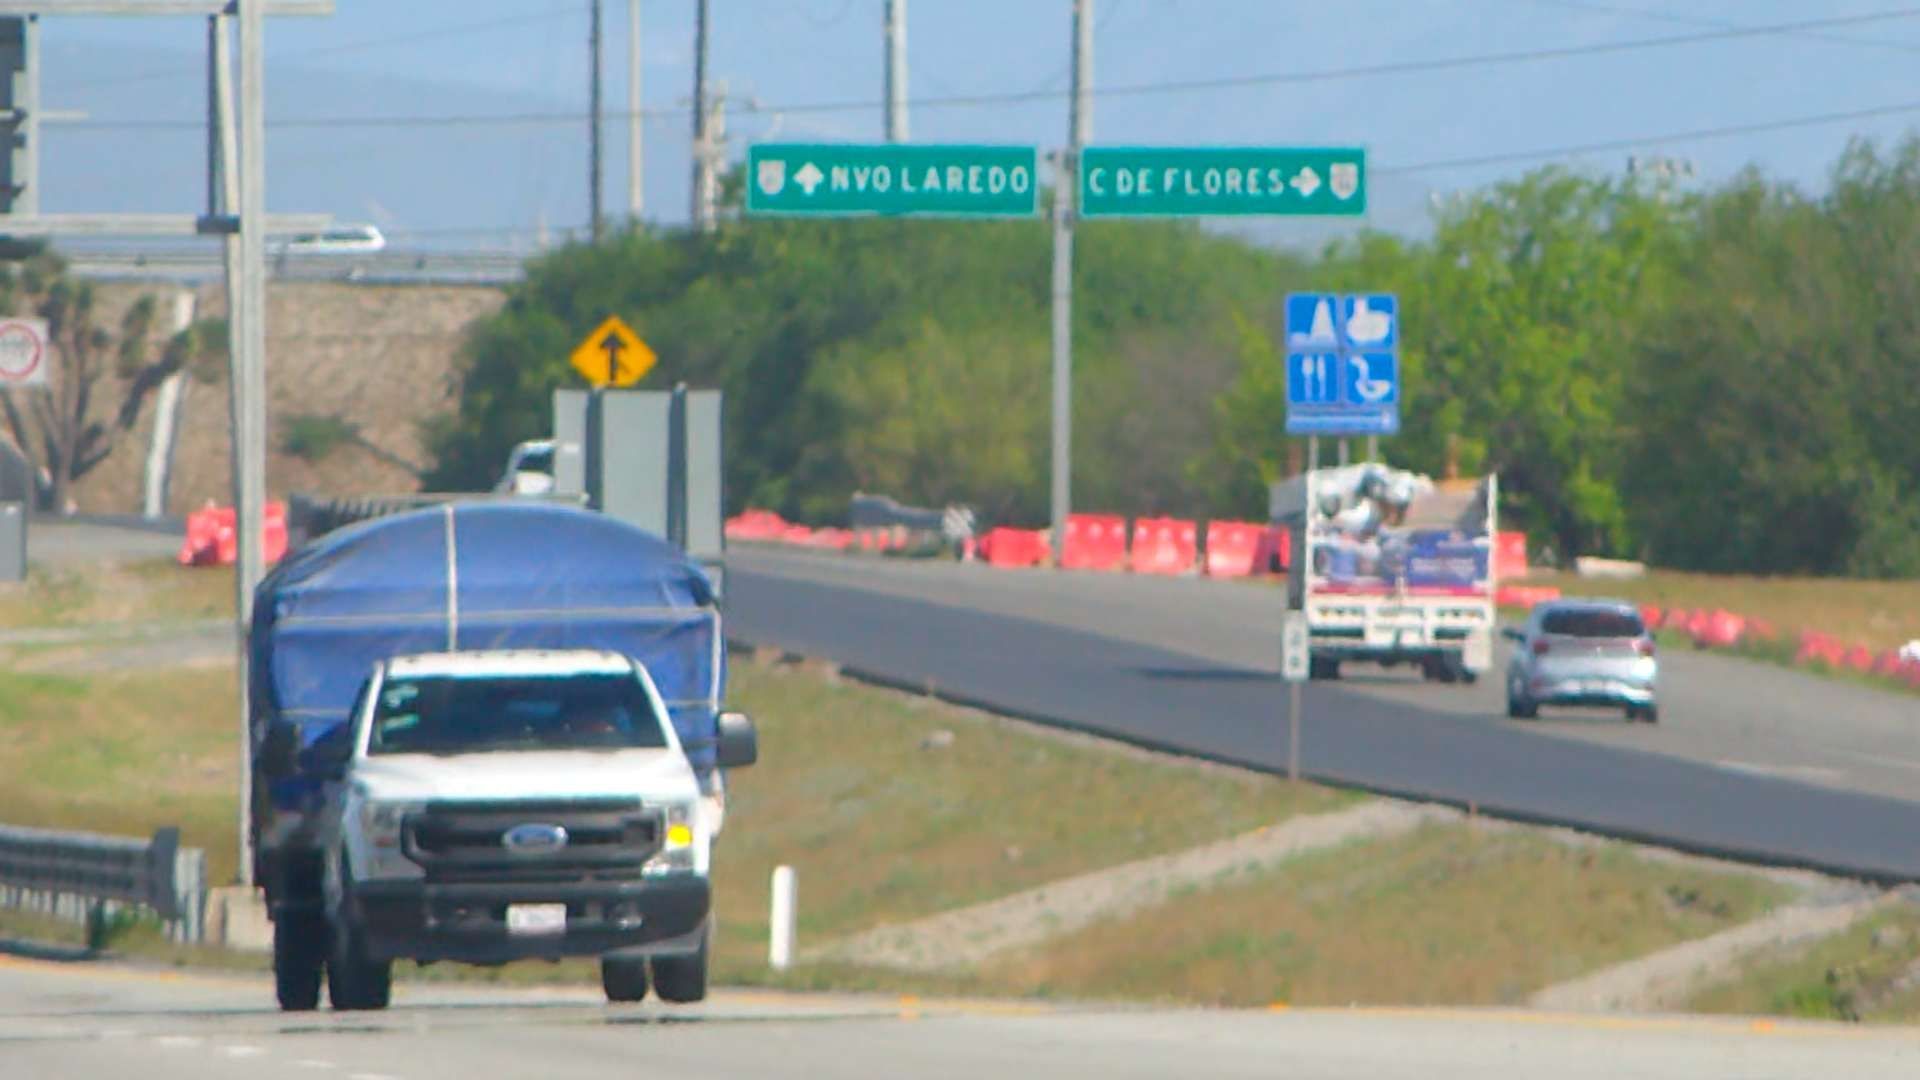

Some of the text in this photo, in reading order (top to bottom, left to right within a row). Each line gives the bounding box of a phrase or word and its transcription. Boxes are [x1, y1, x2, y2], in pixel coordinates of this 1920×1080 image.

[831, 165, 1029, 194] NVO LAREDO
[1089, 167, 1284, 195] C DE FLORES
